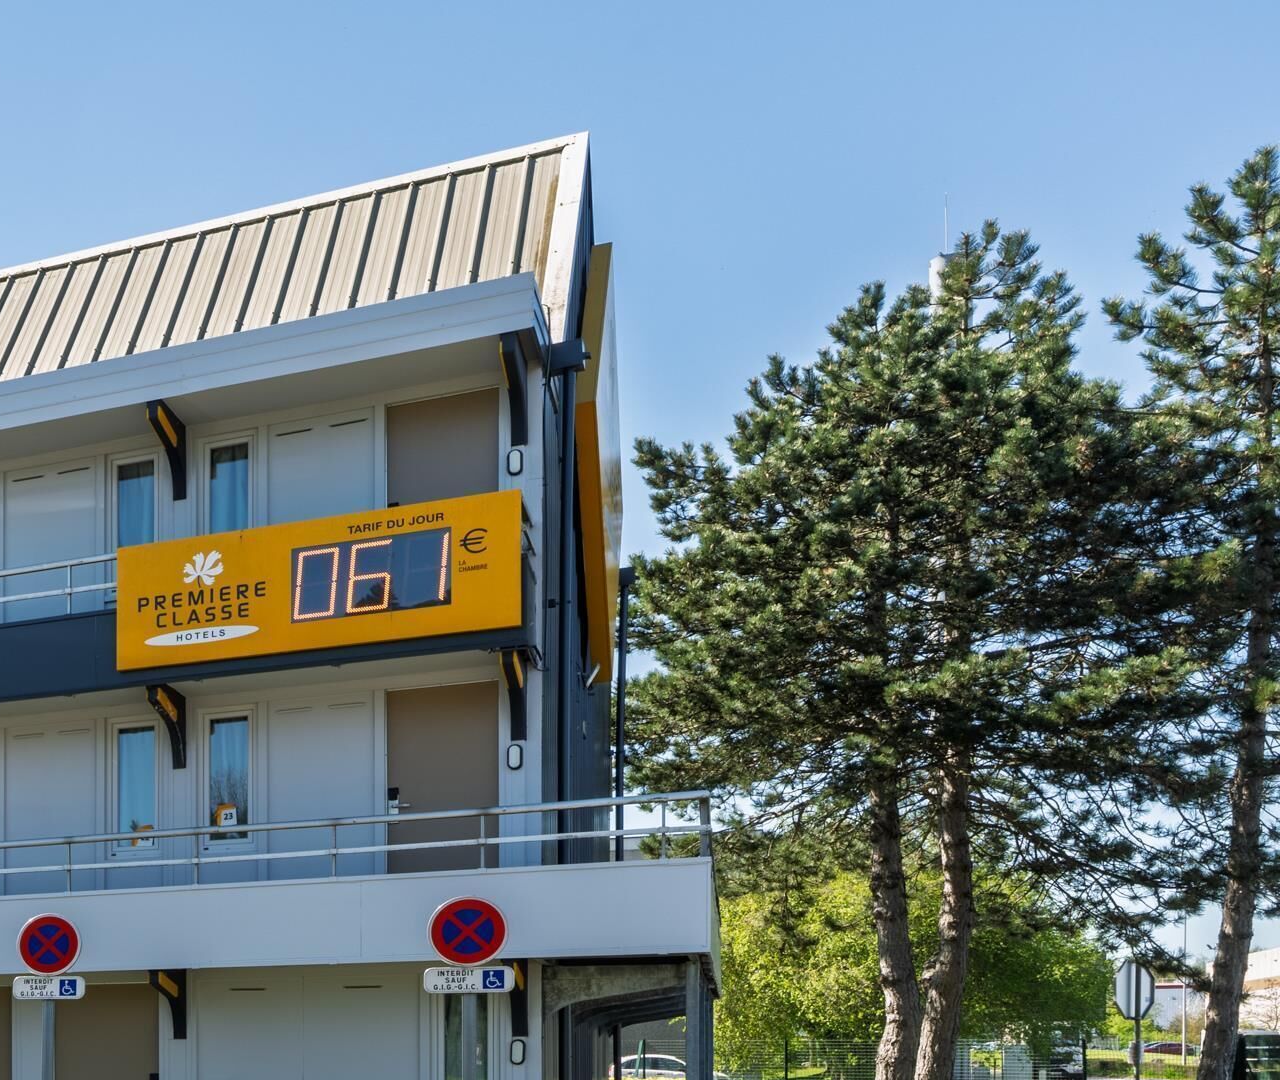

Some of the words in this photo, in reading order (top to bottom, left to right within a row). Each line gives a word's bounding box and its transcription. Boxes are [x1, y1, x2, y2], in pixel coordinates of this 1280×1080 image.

[347, 521, 382, 534] TARIF
[387, 518, 405, 529] DU
[409, 512, 444, 526] JOUR
[460, 528, 488, 553] €
[458, 563, 488, 573] CHAMBRE
[137, 581, 266, 613] PREMIERE
[156, 602, 249, 628] CLASSE
[176, 629, 226, 642] HOTELS
[223, 812, 234, 821] 23
[437, 969, 474, 977] INTERDIT
